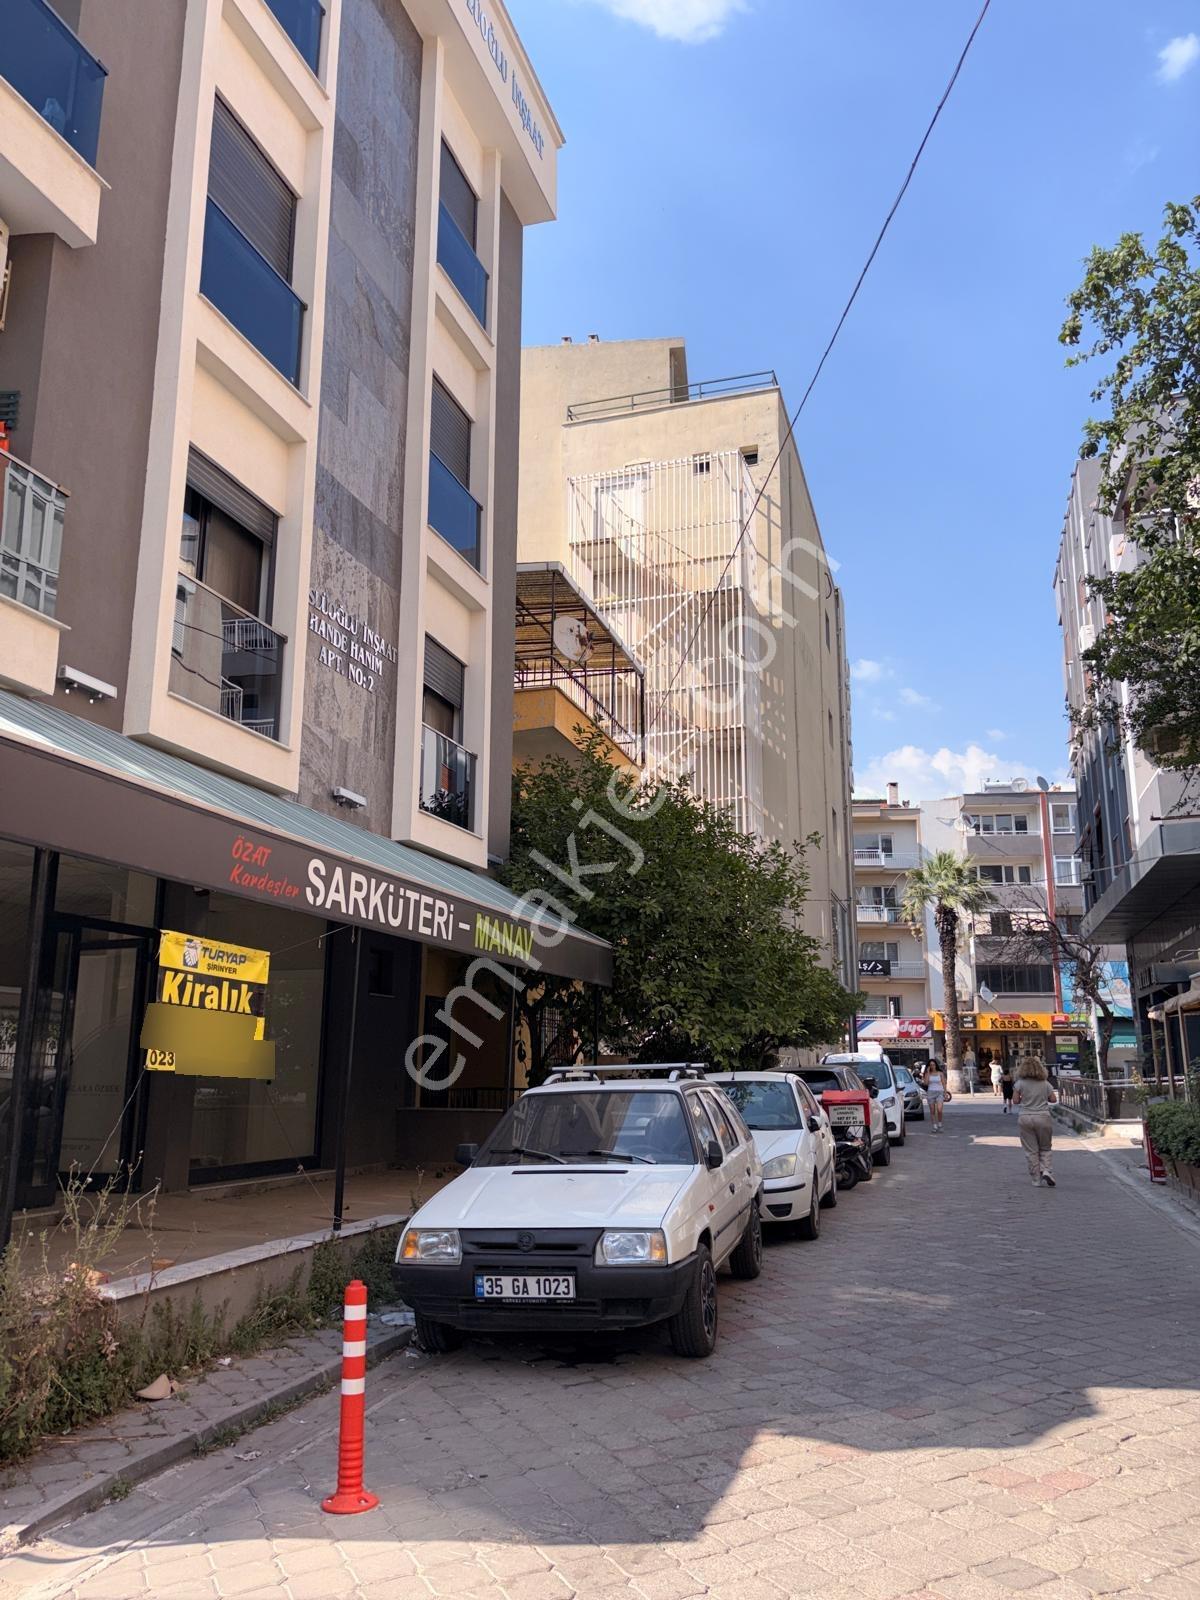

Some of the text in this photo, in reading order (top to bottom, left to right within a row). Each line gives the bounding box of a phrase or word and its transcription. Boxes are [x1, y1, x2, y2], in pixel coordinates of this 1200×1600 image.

[310, 612, 383, 676] HANDE HANIM
[363, 621, 398, 663] İNŞAAT
[319, 646, 374, 692] APT. NO:2
[232, 835, 272, 868] ÖZAT
[230, 863, 300, 897] Kardeşler
[475, 912, 534, 960] MANAV
[201, 946, 247, 965] TURYAP
[161, 970, 253, 1014] Kiralık
[900, 1020, 926, 1035] dyo
[990, 1017, 1038, 1029] Kasaba
[485, 1278, 503, 1295] 35
[512, 1278, 529, 1296] GA
[535, 1278, 570, 1296] 1023
